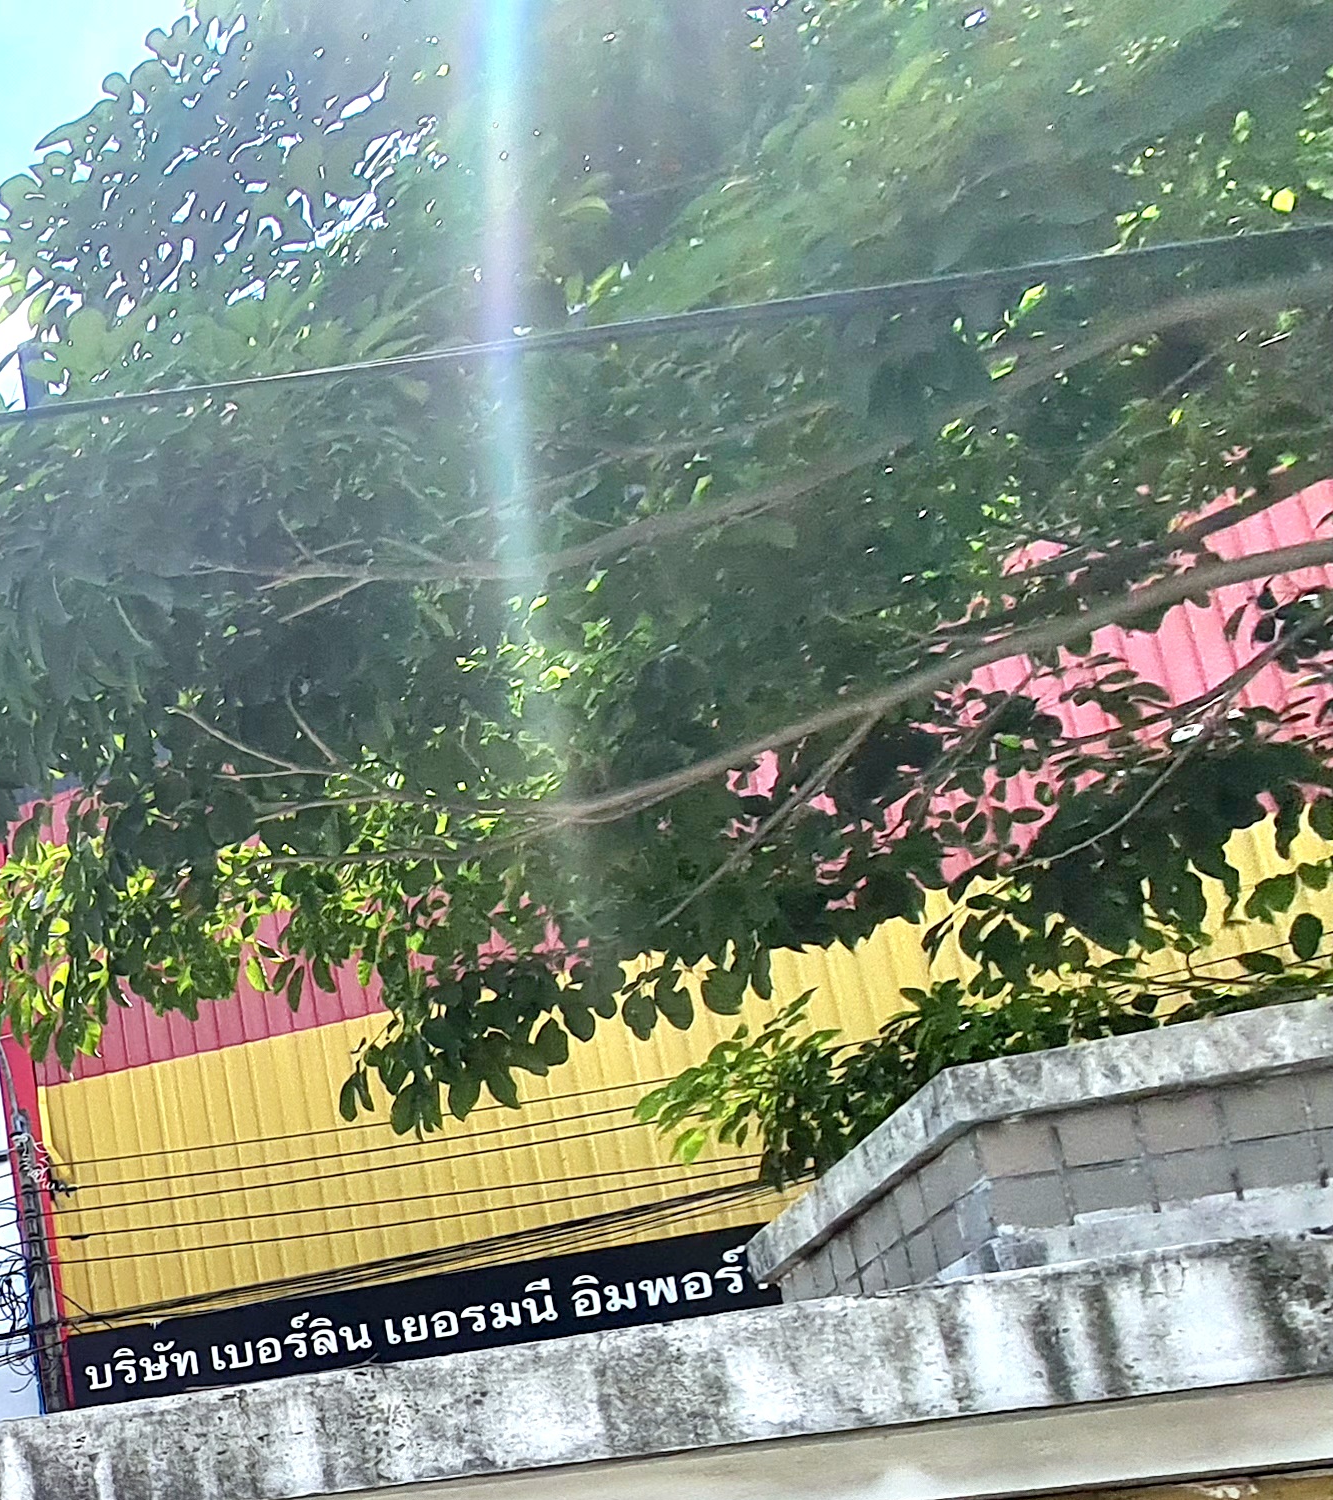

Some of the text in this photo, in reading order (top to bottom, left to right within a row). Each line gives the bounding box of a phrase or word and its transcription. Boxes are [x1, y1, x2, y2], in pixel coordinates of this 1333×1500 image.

[84, 1244, 769, 1391] บริษัท เบอร์ลิน เยอรมนี อิมพอร์
